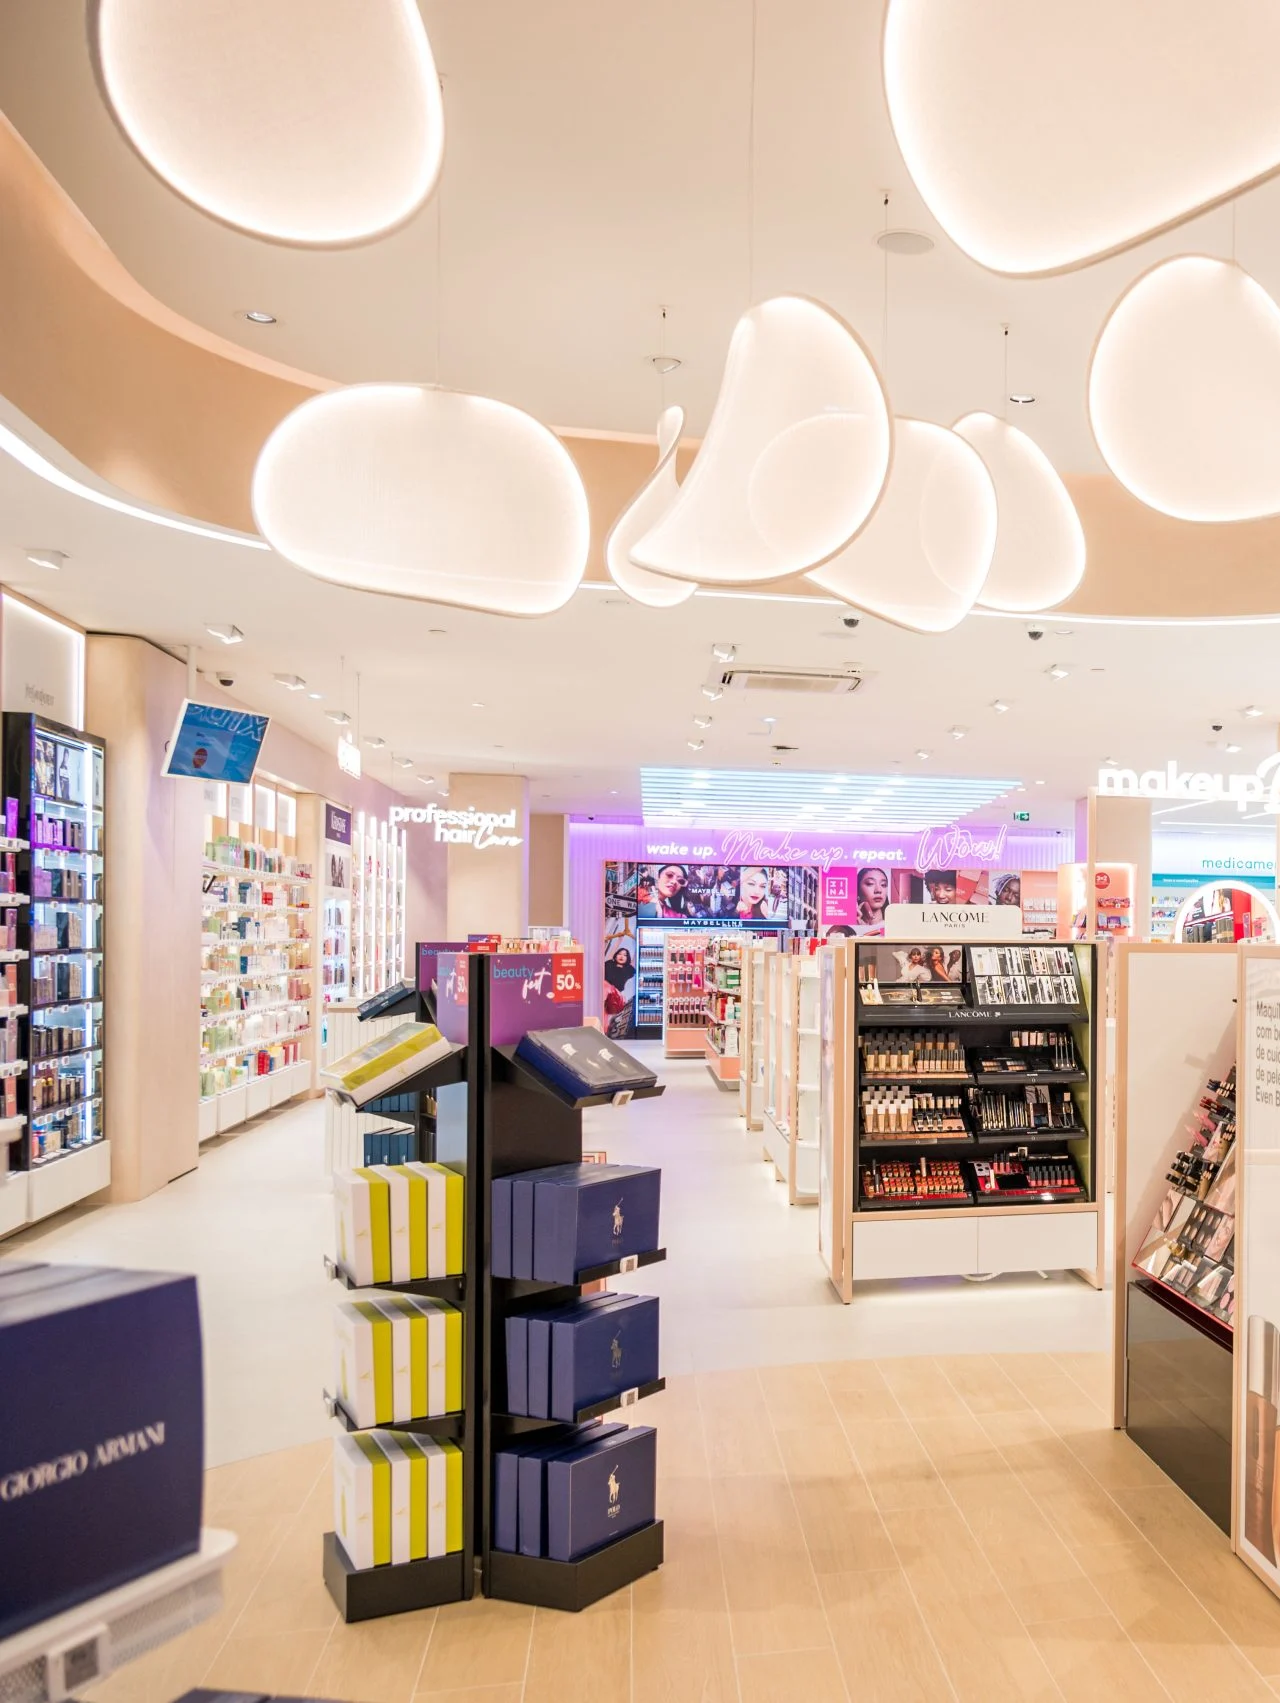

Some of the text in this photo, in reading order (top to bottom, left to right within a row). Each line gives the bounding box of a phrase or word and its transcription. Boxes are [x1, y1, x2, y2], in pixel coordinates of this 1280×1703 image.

[1098, 760, 1264, 812] makeup
[389, 803, 516, 828] professional
[434, 821, 475, 843] hair
[647, 842, 688, 856] wake
[692, 844, 717, 861] up.
[721, 828, 807, 866] Make
[852, 849, 906, 863] repeat.
[915, 823, 1008, 873] Wow!
[1202, 856, 1276, 870] medicame
[606, 897, 620, 905] ONE
[921, 910, 989, 923] LANCÔME
[493, 965, 535, 979] beauty
[556, 974, 581, 991] 50%
[948, 1010, 992, 1018] LANCÔME
[1256, 1026, 1272, 1040] com
[1256, 1044, 1265, 1060] de
[1256, 1064, 1265, 1081] de
[1255, 1086, 1274, 1105] Even
[0, 1421, 166, 1500] GIORGIO ARMANI
